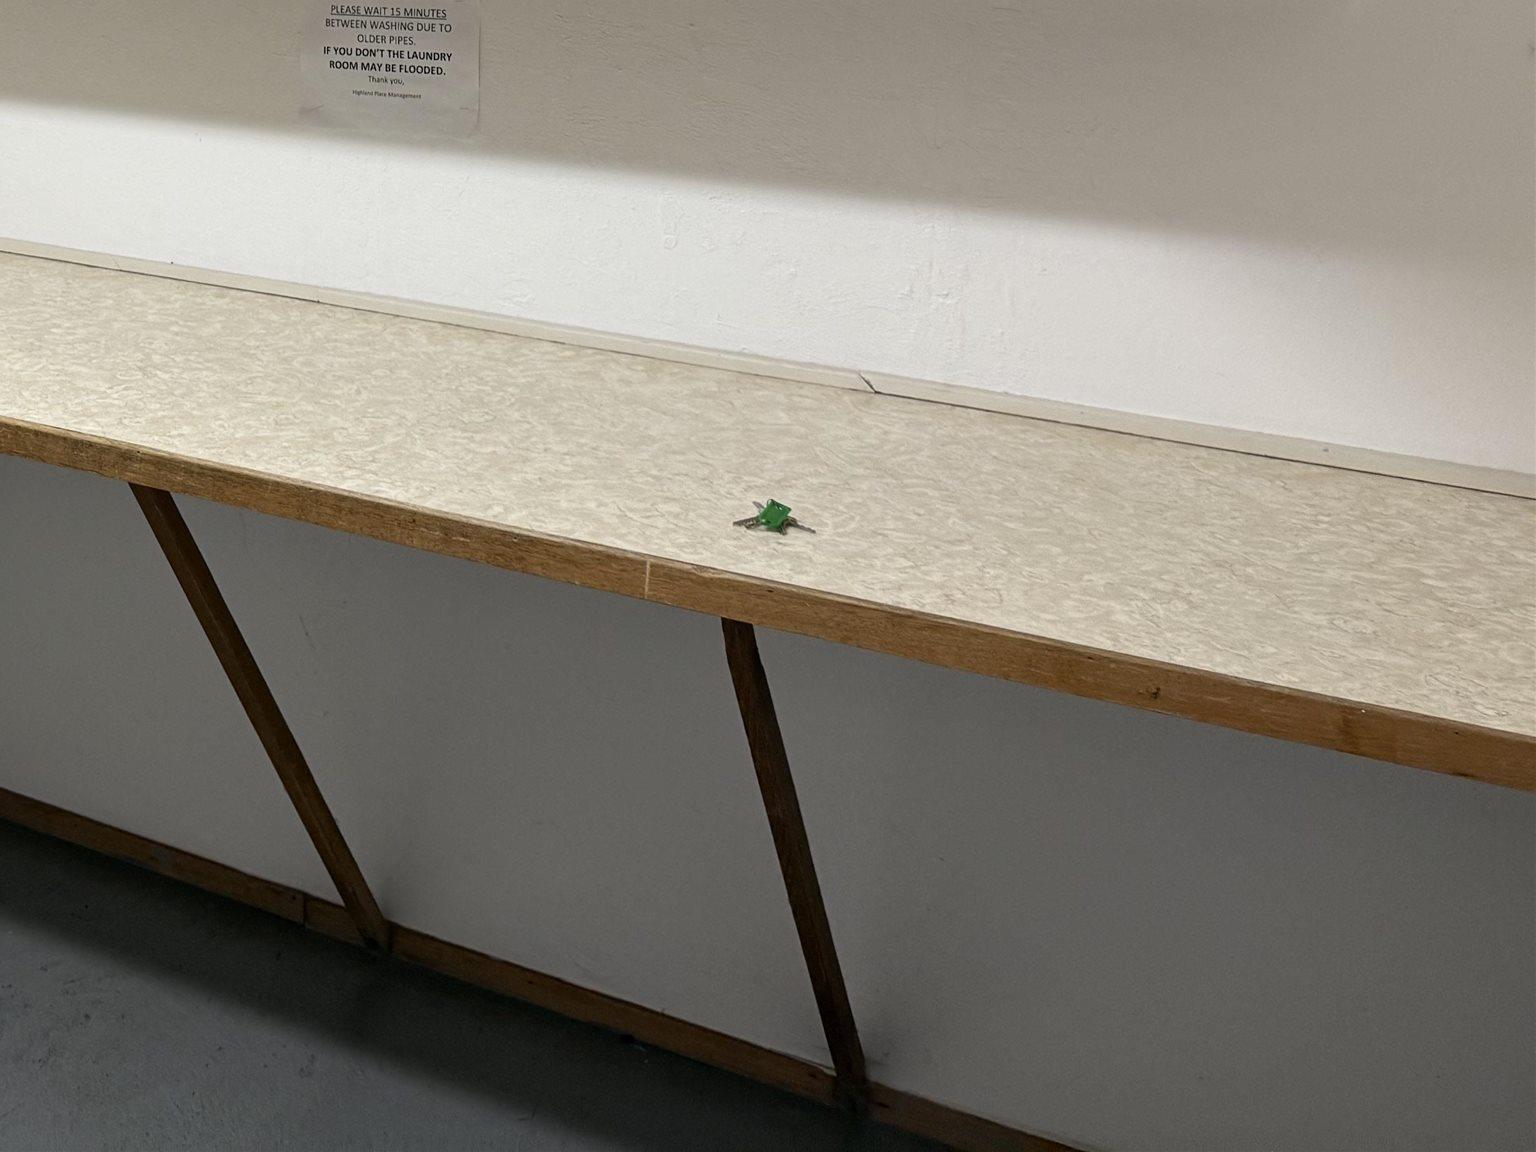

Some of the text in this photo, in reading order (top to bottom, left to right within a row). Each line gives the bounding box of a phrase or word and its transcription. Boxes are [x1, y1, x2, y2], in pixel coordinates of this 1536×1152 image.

[330, 5, 447, 19] PLEASE WAIT 15 MINUTES
[325, 18, 452, 33] BETWEEN WASHING DUE TO
[357, 34, 416, 46] OLDER PIPES.
[324, 46, 331, 55] IF
[333, 47, 353, 56] YOU
[387, 49, 405, 59] THE
[407, 51, 452, 61] LAUNDRY
[329, 60, 446, 76] ROOM MAY BE FLOODED.
[368, 76, 405, 86] Thank you,
[352, 89, 374, 97] Highland
[388, 92, 422, 100] Management
